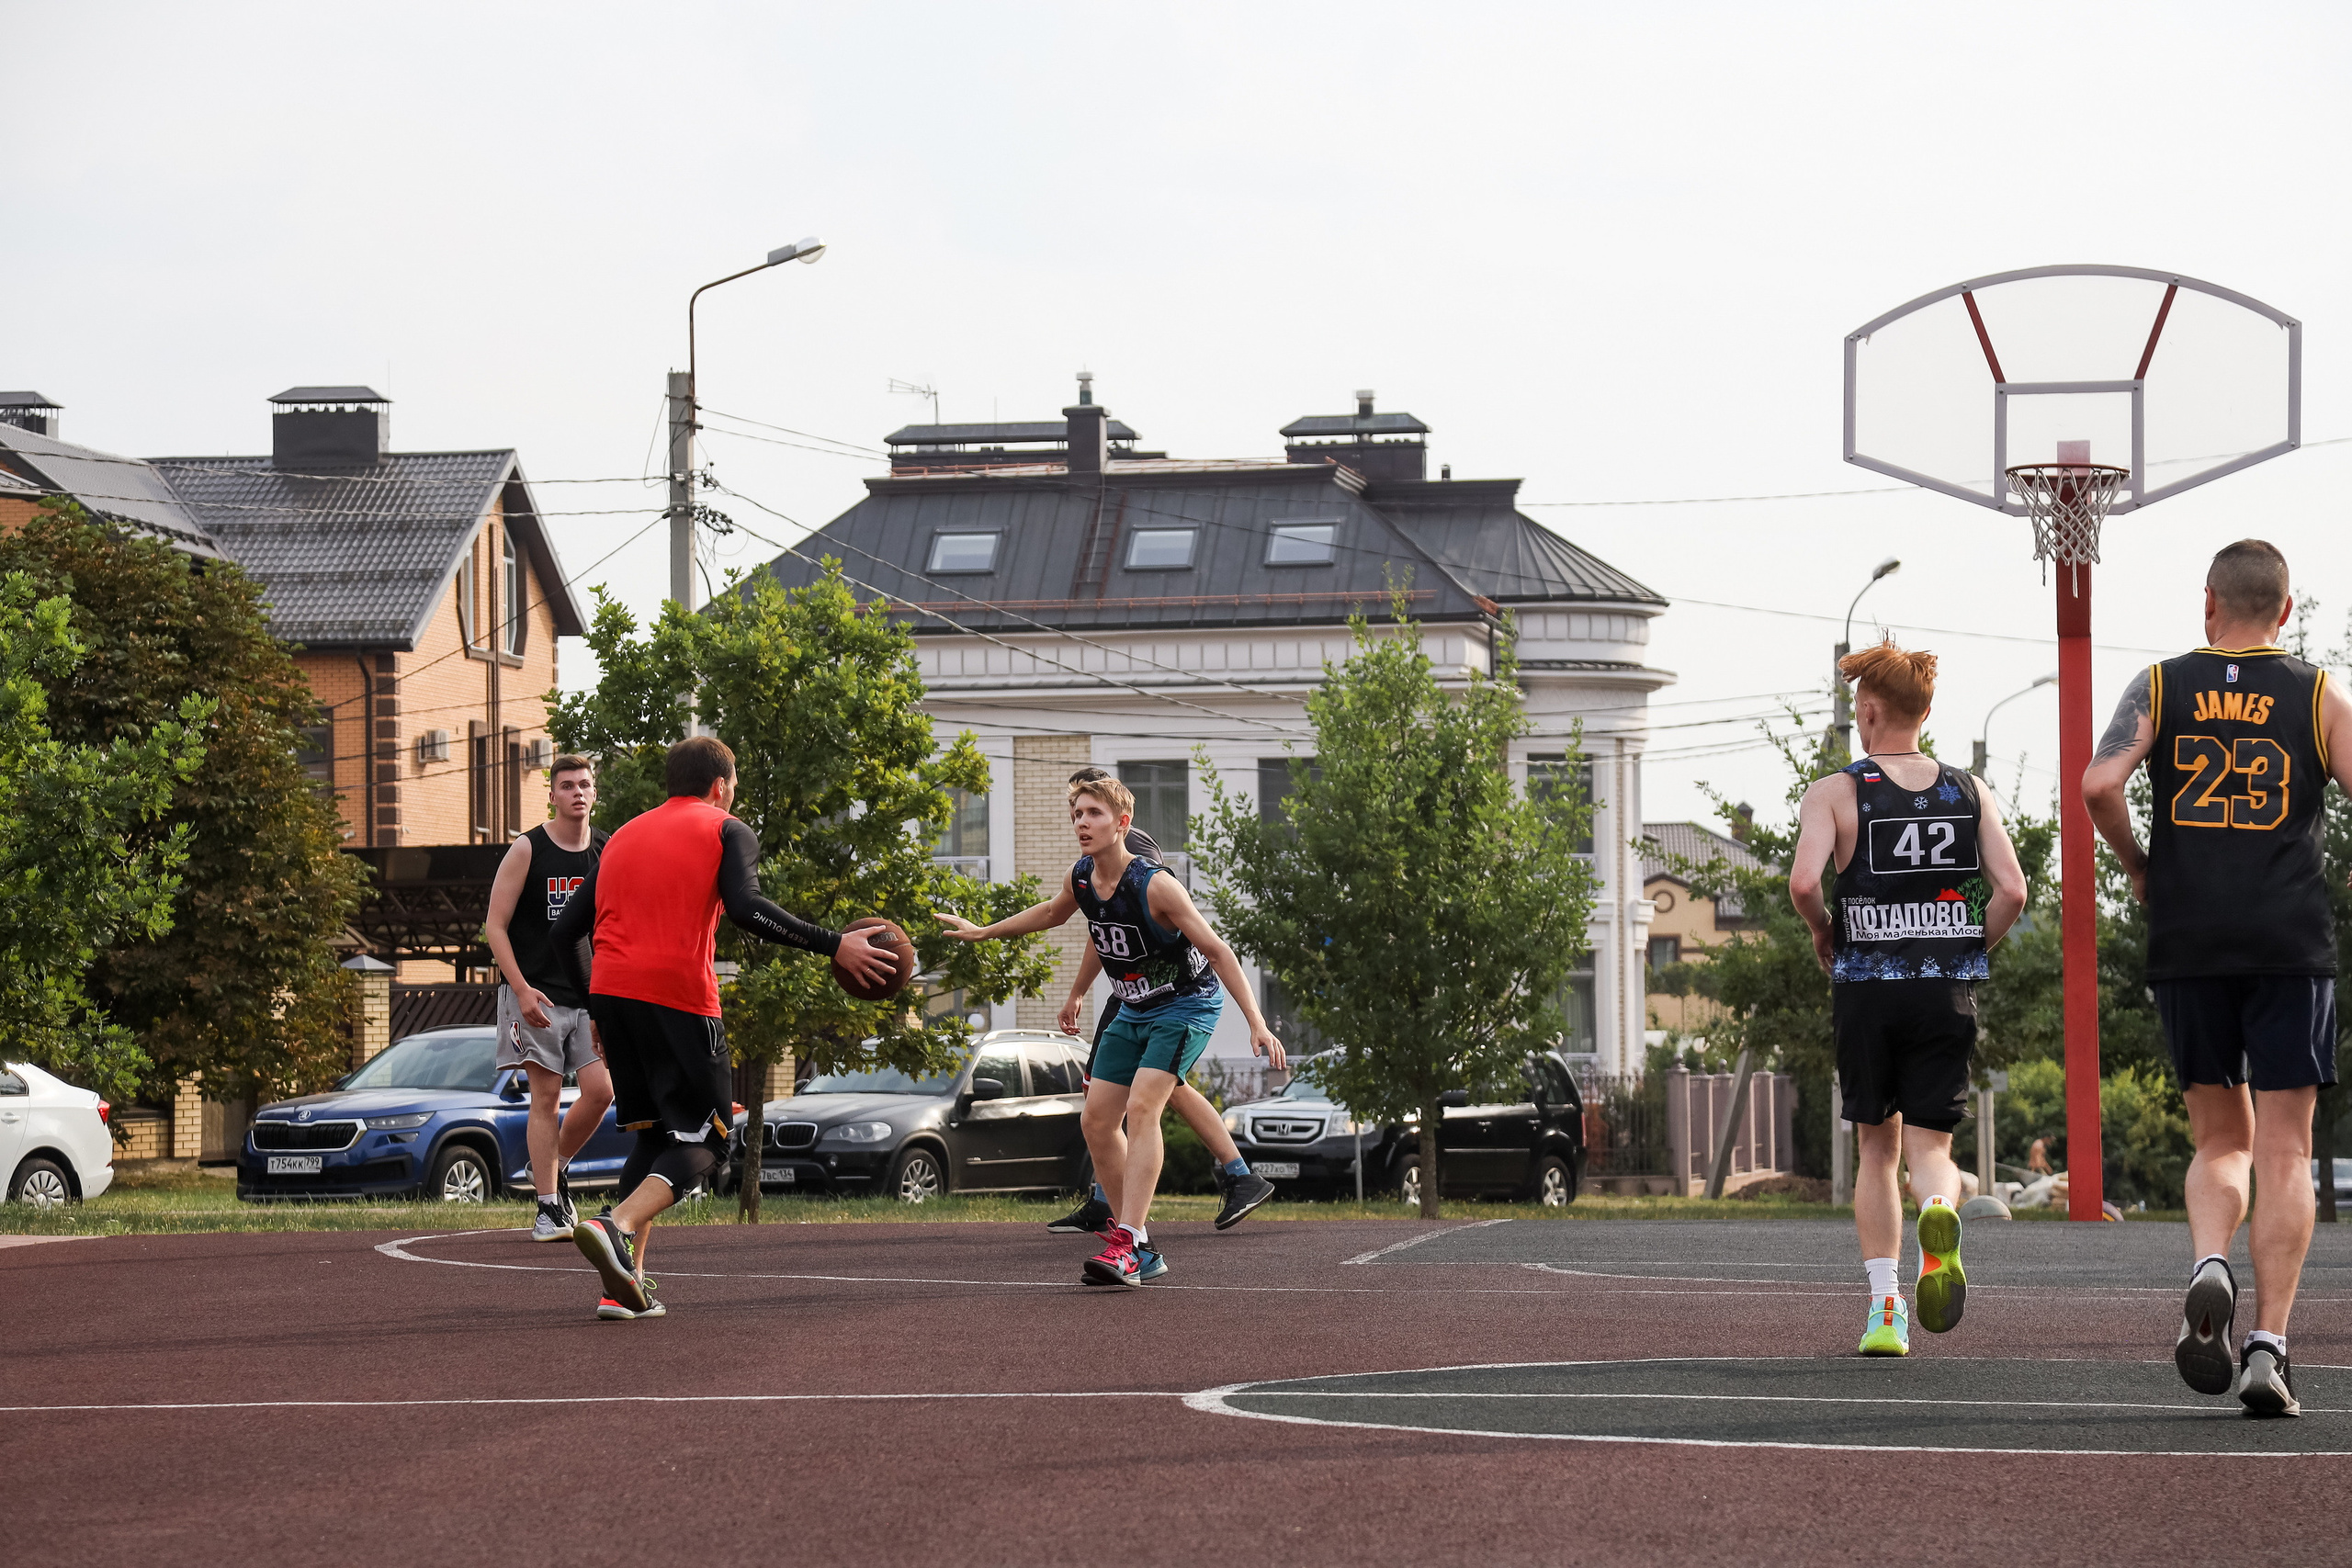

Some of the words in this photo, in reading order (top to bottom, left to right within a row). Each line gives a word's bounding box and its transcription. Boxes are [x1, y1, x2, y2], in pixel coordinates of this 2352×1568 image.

[2193, 690, 2275, 725] JAMES
[2171, 735, 2291, 830] 23
[1893, 822, 1956, 866] 42
[1848, 895, 1876, 905] посёлок
[753, 911, 788, 936] ROLLING
[1848, 901, 1968, 931] ПОТАПОВО
[788, 932, 808, 945] KEEP
[1091, 924, 1130, 957] 38
[1856, 931, 1880, 940] Моя
[1883, 928, 1948, 938] маленькая
